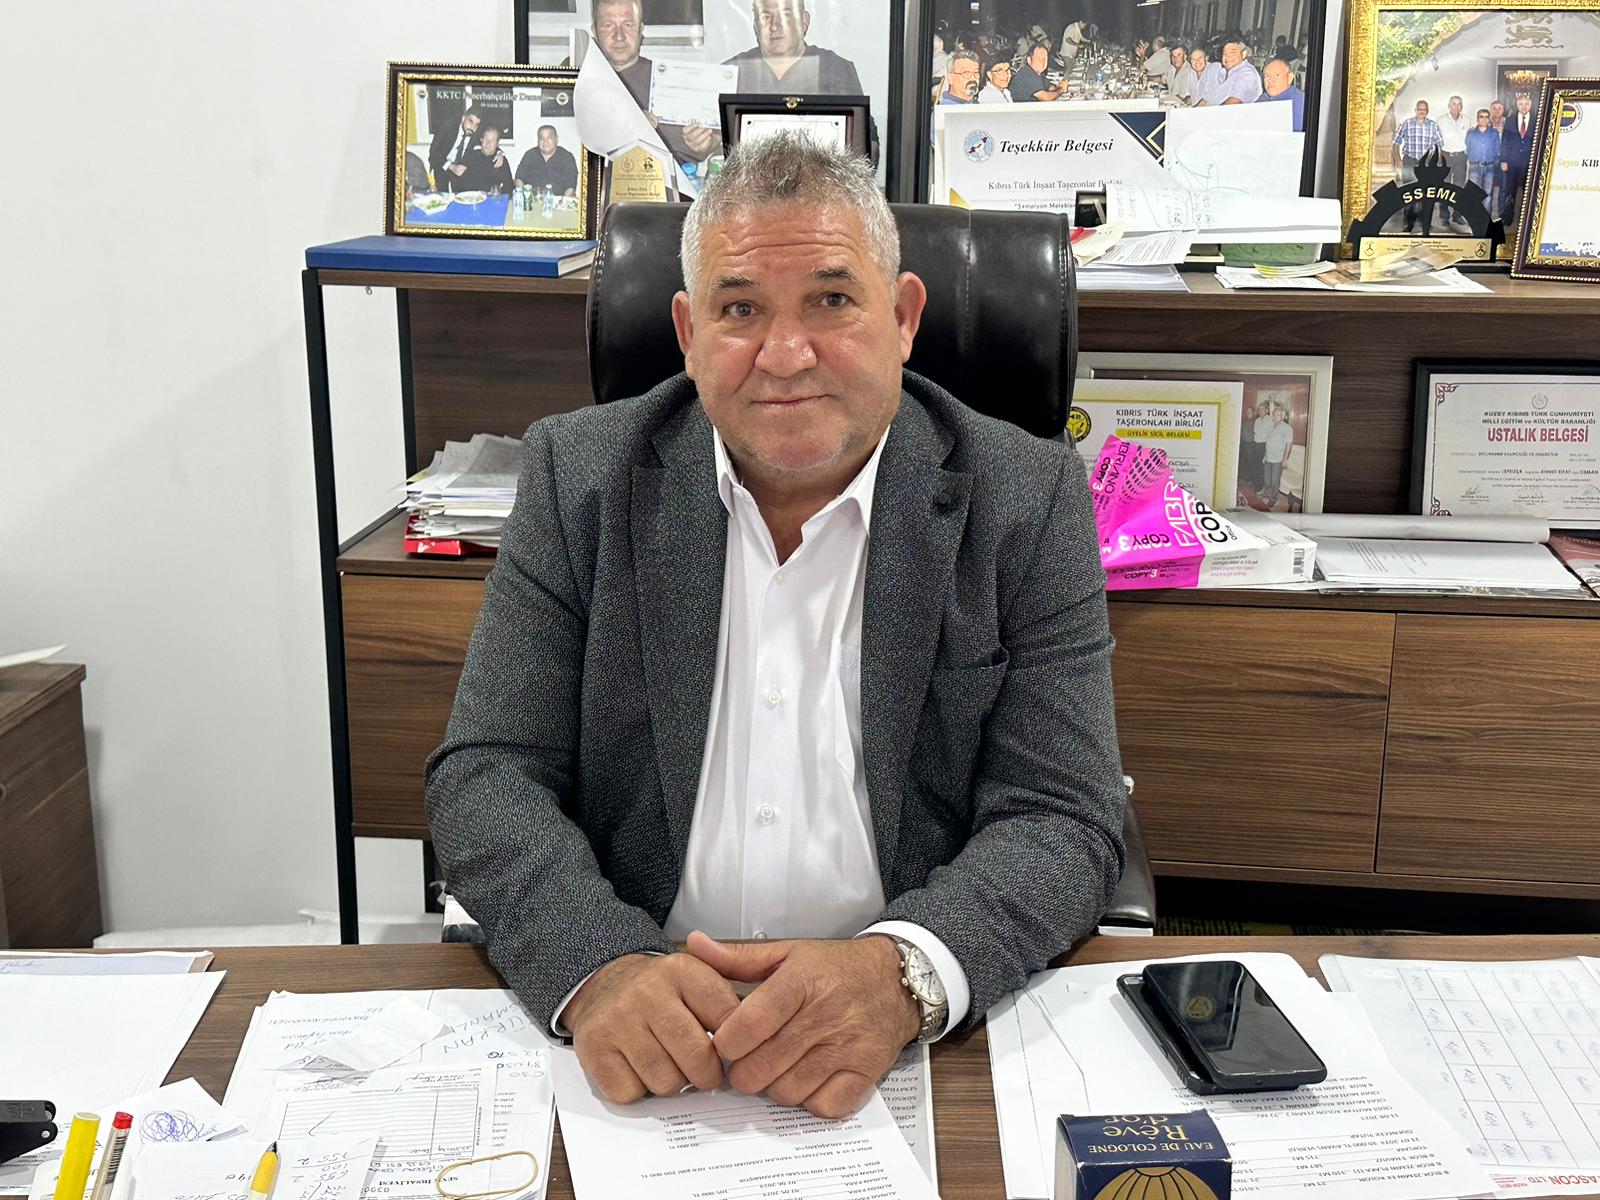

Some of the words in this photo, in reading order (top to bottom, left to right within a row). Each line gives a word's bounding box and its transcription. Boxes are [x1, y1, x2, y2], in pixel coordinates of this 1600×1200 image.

[436, 90, 461, 100] KKTC
[1000, 140, 1060, 154] Teşekkür
[1064, 138, 1114, 154] Belgesi
[1582, 158, 1600, 168] KIB
[988, 181, 1012, 190] Kıbrıs
[1013, 180, 1031, 190] Türk
[1033, 180, 1055, 191] İnşaat
[1402, 186, 1457, 204] SSEML
[1116, 409, 1142, 417] KIBRIS
[1148, 408, 1168, 417] TÜRK
[1174, 408, 1204, 418] İNŞAAT
[1116, 419, 1172, 428] TAŞERONLARI
[1175, 418, 1204, 427] BİRLİĞİ
[1488, 428, 1536, 442] USTALIK
[1540, 425, 1589, 442] BELGESİ
[1097, 457, 1113, 484] COPY
[1195, 498, 1228, 543] COP
[1118, 536, 1132, 552] 3
[1132, 534, 1171, 550] COPY
[1104, 1114, 1169, 1125] d'or
[1102, 1124, 1189, 1141] Rêve
[1088, 1143, 1156, 1154] COLOGNE
[1160, 1142, 1180, 1152] DE
[1184, 1142, 1214, 1151] EAU
[860, 1168, 884, 1176] ALINAN
[864, 1176, 888, 1184] ALINAN
[1548, 1175, 1600, 1186] ASCON
[866, 1184, 892, 1192] ALINAN
